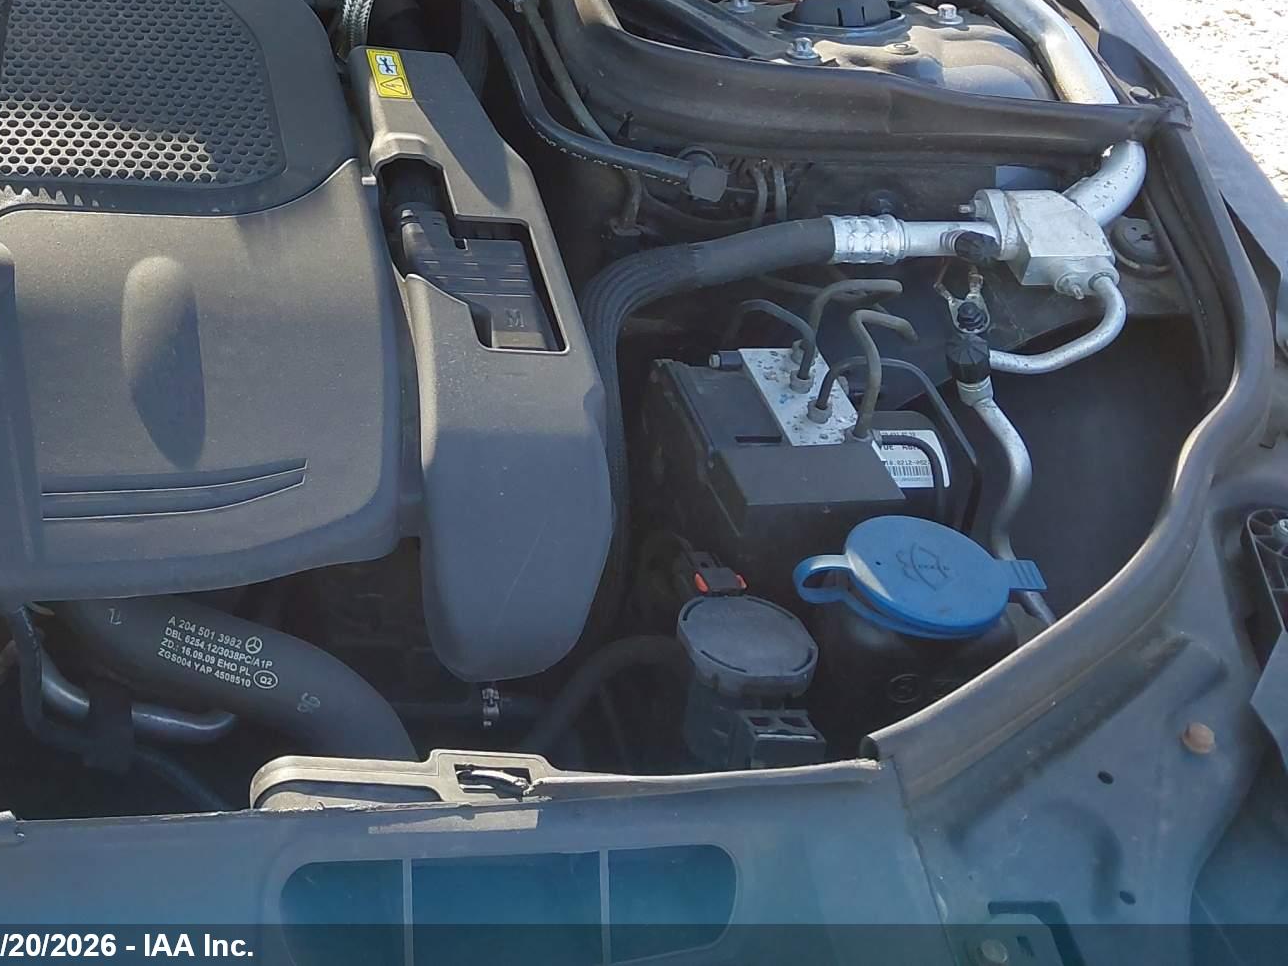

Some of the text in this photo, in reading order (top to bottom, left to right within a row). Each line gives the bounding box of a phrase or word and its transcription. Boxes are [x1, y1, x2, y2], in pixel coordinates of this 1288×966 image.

[165, 627, 183, 641] DBL
[168, 616, 242, 649] A 204 501 3982
[158, 647, 192, 667] ZGS004
[193, 661, 213, 675] YAP
[239, 665, 251, 676] PL
[259, 675, 273, 685] Q2
